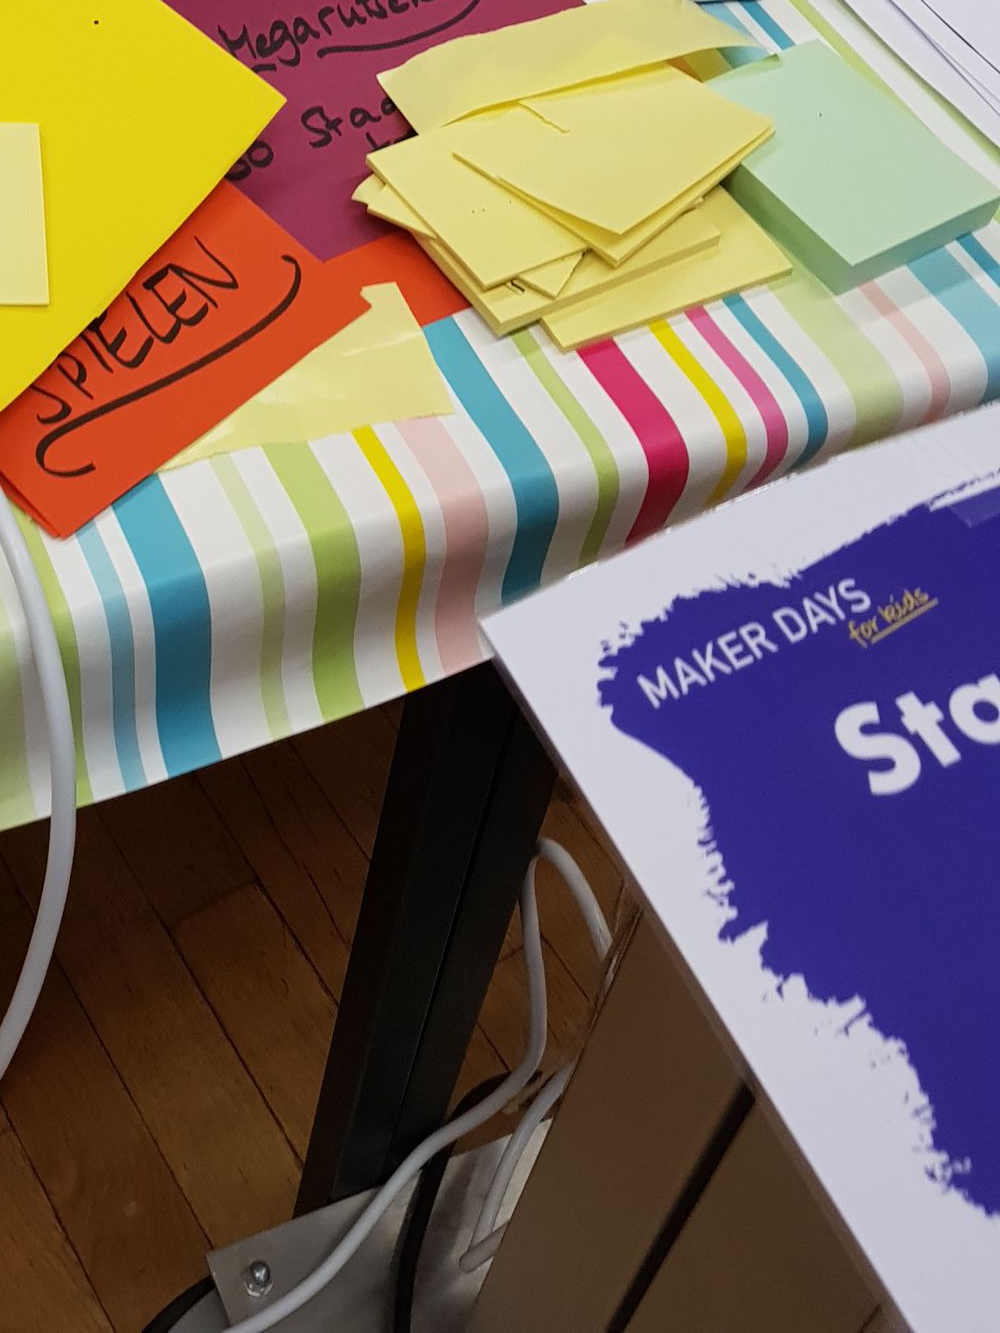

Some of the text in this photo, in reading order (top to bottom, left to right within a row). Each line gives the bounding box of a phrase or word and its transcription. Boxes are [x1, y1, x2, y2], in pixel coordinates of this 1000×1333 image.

[29, 234, 240, 425] SPIELEN
[636, 577, 930, 710] MAKER DAYS for kids
[834, 672, 1000, 797] Sta
